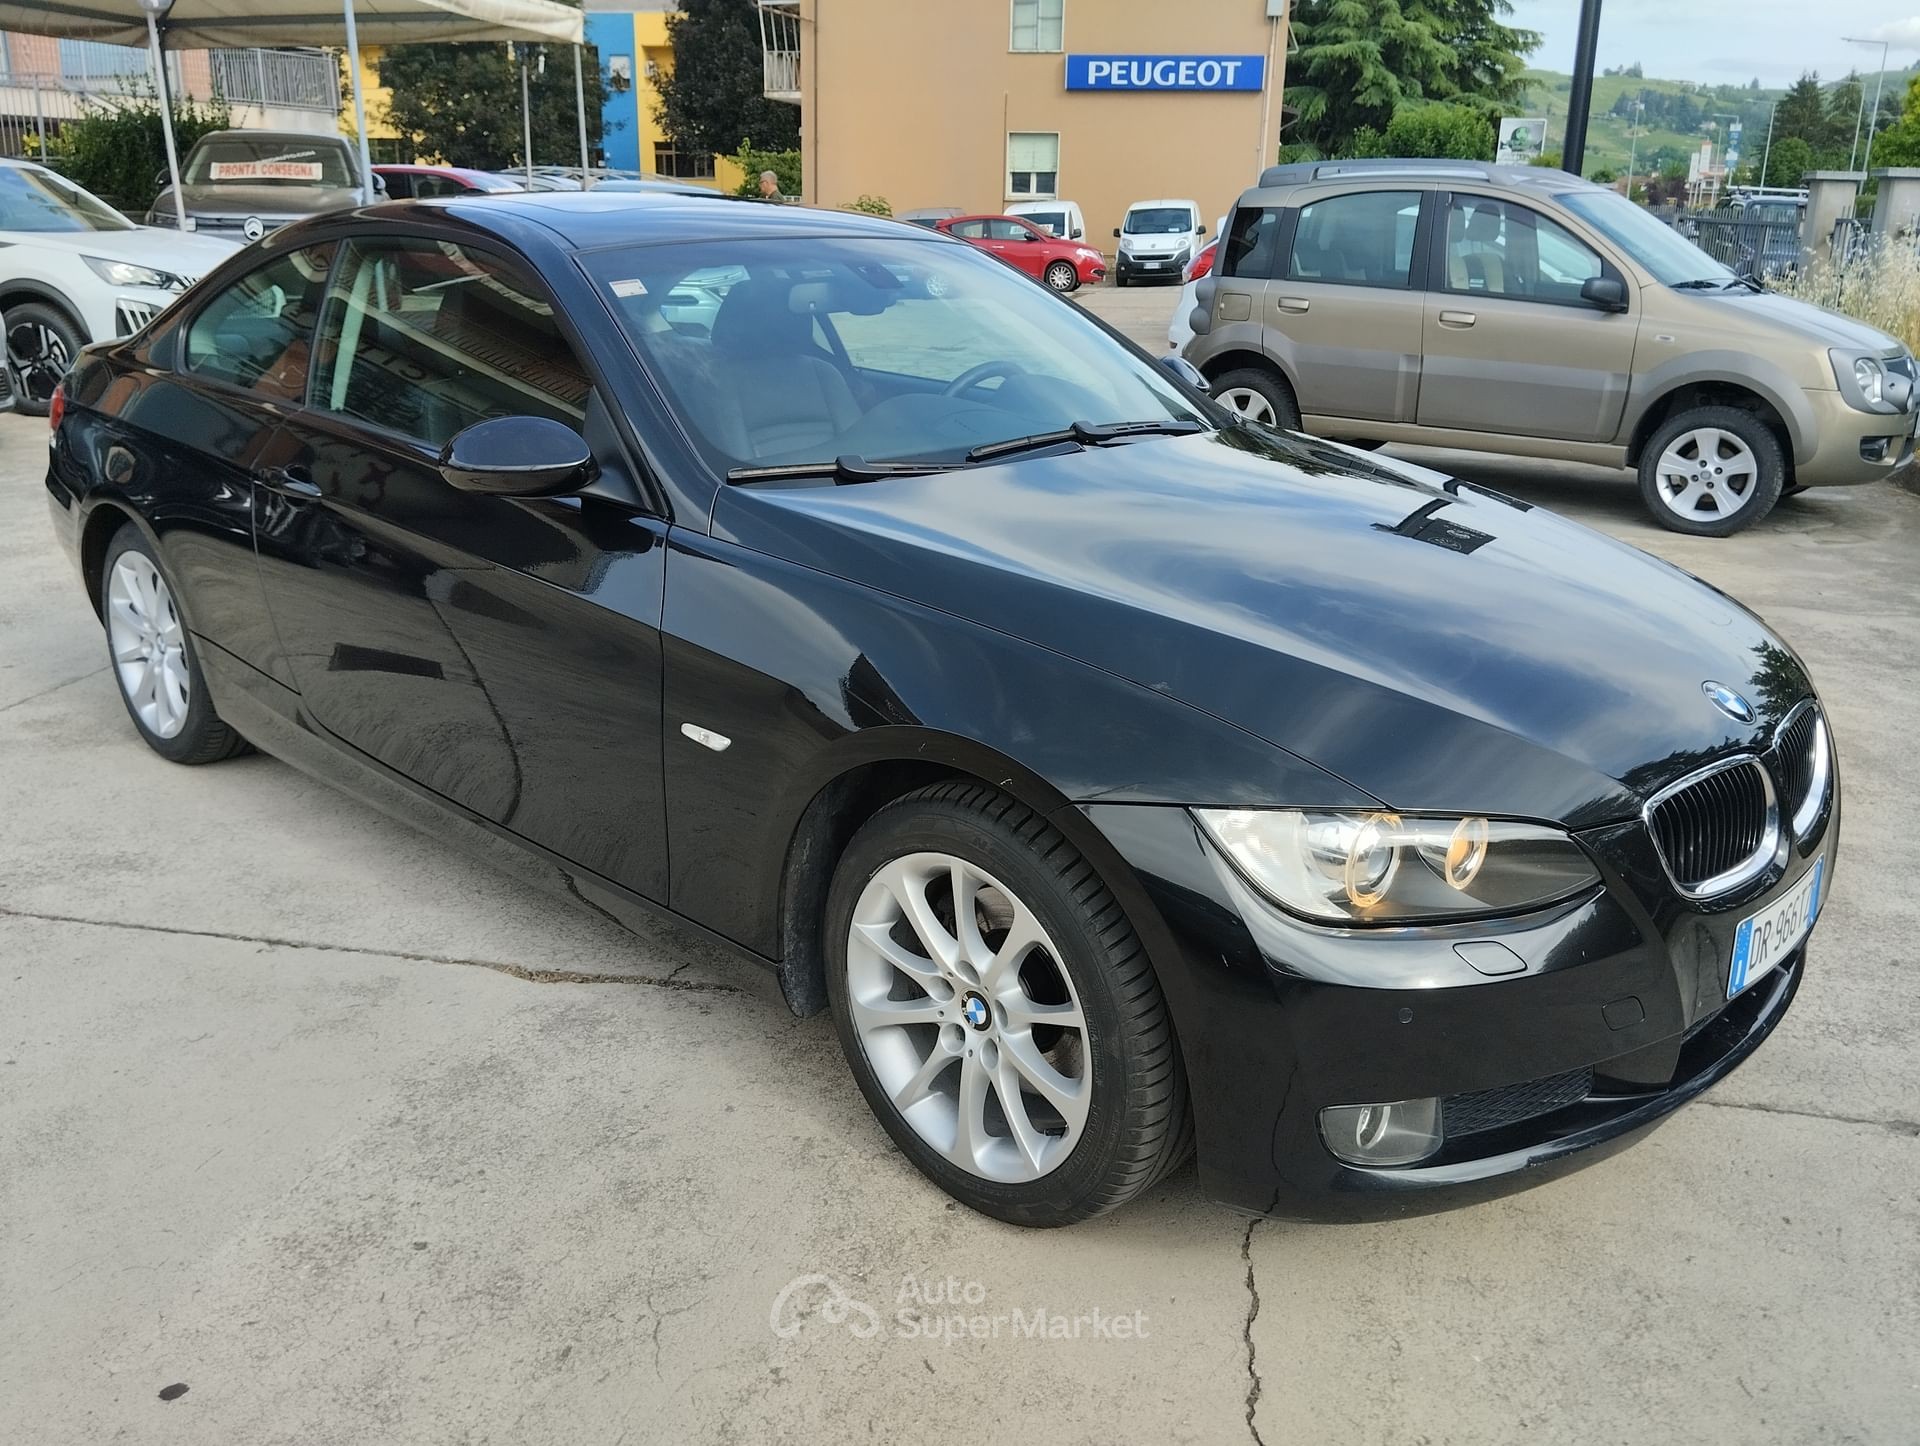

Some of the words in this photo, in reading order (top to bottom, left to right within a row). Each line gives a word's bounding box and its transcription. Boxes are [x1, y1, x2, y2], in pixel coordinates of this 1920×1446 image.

[1087, 60, 1243, 87] PEUGEOT
[218, 163, 257, 177] PRONTA
[261, 164, 315, 177] CONSEGNA
